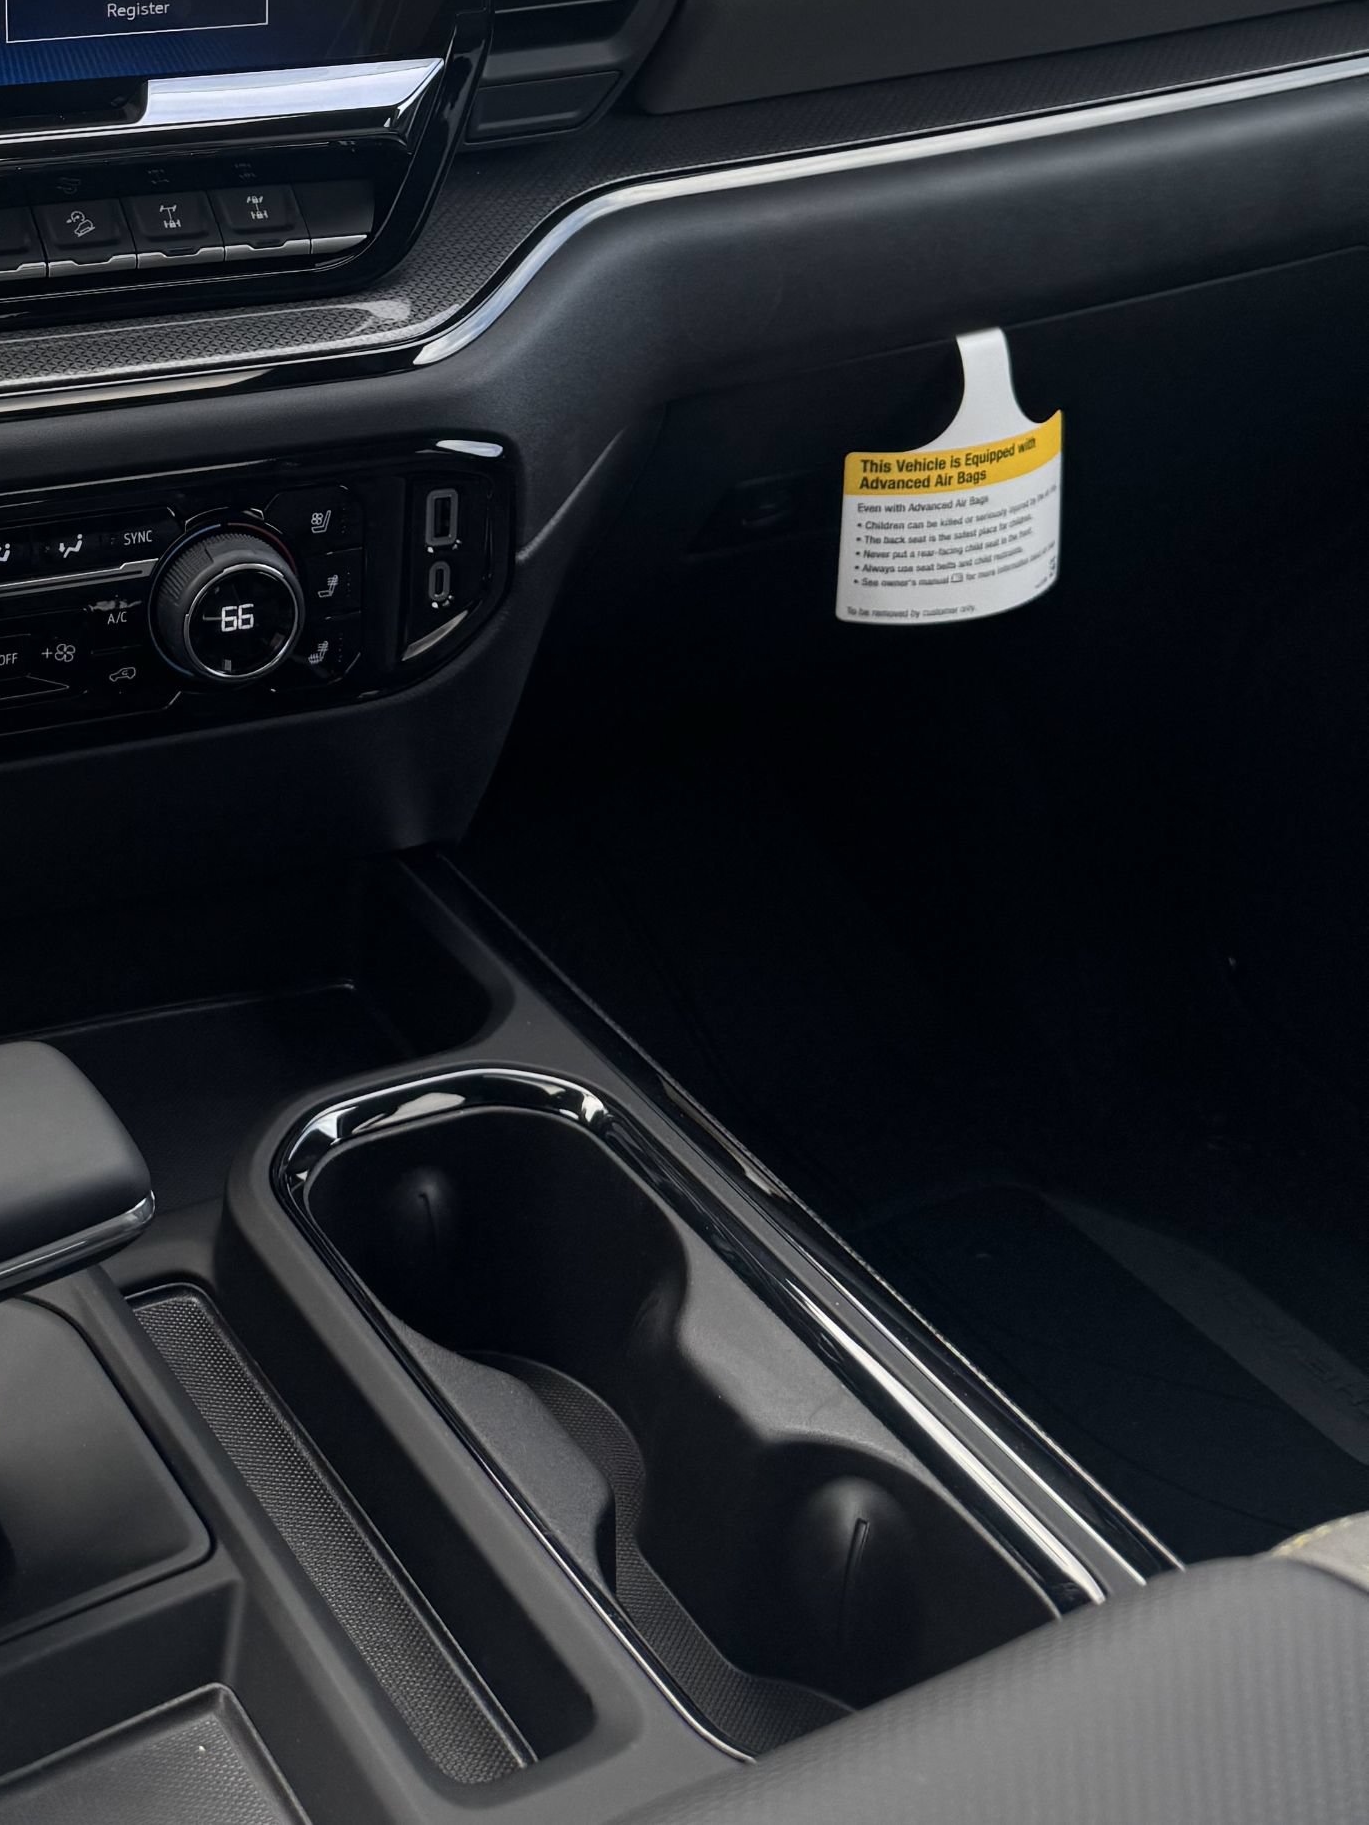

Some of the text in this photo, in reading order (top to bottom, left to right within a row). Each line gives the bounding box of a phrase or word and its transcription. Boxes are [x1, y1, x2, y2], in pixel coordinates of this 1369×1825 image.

[106, 0, 171, 20] Register
[860, 436, 1037, 474] This Vehicle is Equipped with
[859, 469, 987, 491] Advanced Air Bags
[857, 495, 989, 514] Even with Advanced Air Bags
[865, 520, 905, 530] Children
[907, 521, 925, 530] can
[123, 529, 153, 547] SYNC
[865, 534, 881, 544] The
[883, 534, 905, 545] back
[908, 534, 927, 544] seat
[863, 549, 890, 560] Never
[892, 549, 908, 560] put
[861, 563, 895, 575] Always
[897, 564, 914, 573] use
[860, 576, 879, 587] See
[107, 611, 128, 625] A/C
[220, 603, 255, 633] 66
